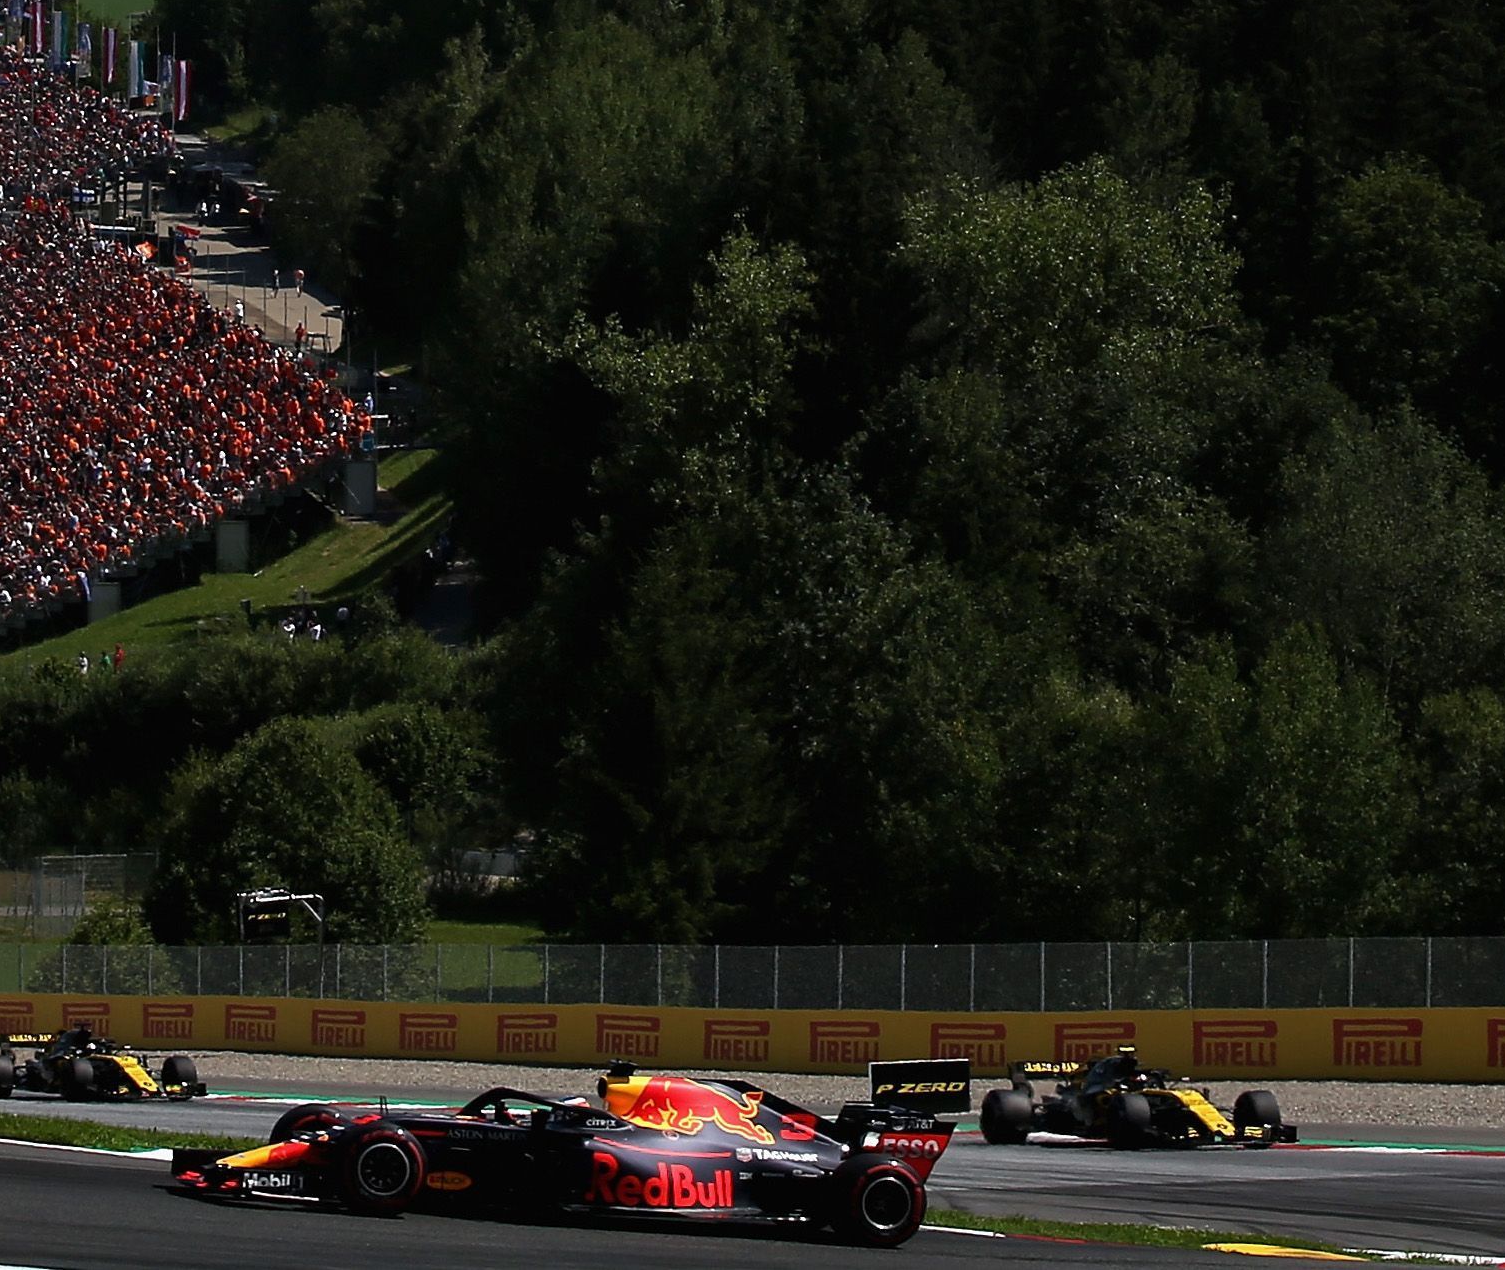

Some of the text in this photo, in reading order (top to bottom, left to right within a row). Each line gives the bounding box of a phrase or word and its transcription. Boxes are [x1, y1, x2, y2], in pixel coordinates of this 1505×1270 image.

[143, 1003, 193, 1038] PIRELLI
[225, 1004, 276, 1042] PIRELLI
[312, 1009, 366, 1047] PIRELLI
[399, 1013, 457, 1052] PIRELLI
[497, 1014, 557, 1053] PIRELLI
[596, 1014, 660, 1057] PIRELLI
[704, 1020, 770, 1062] PIRELLI
[810, 1021, 880, 1063] PIRELLI
[1193, 1020, 1278, 1067] PIRELLI
[1333, 1019, 1423, 1066] PIRELLI
[876, 1081, 966, 1094] P ZERO
[447, 1130, 483, 1139] ASTON
[242, 1172, 290, 1188] Mobil
